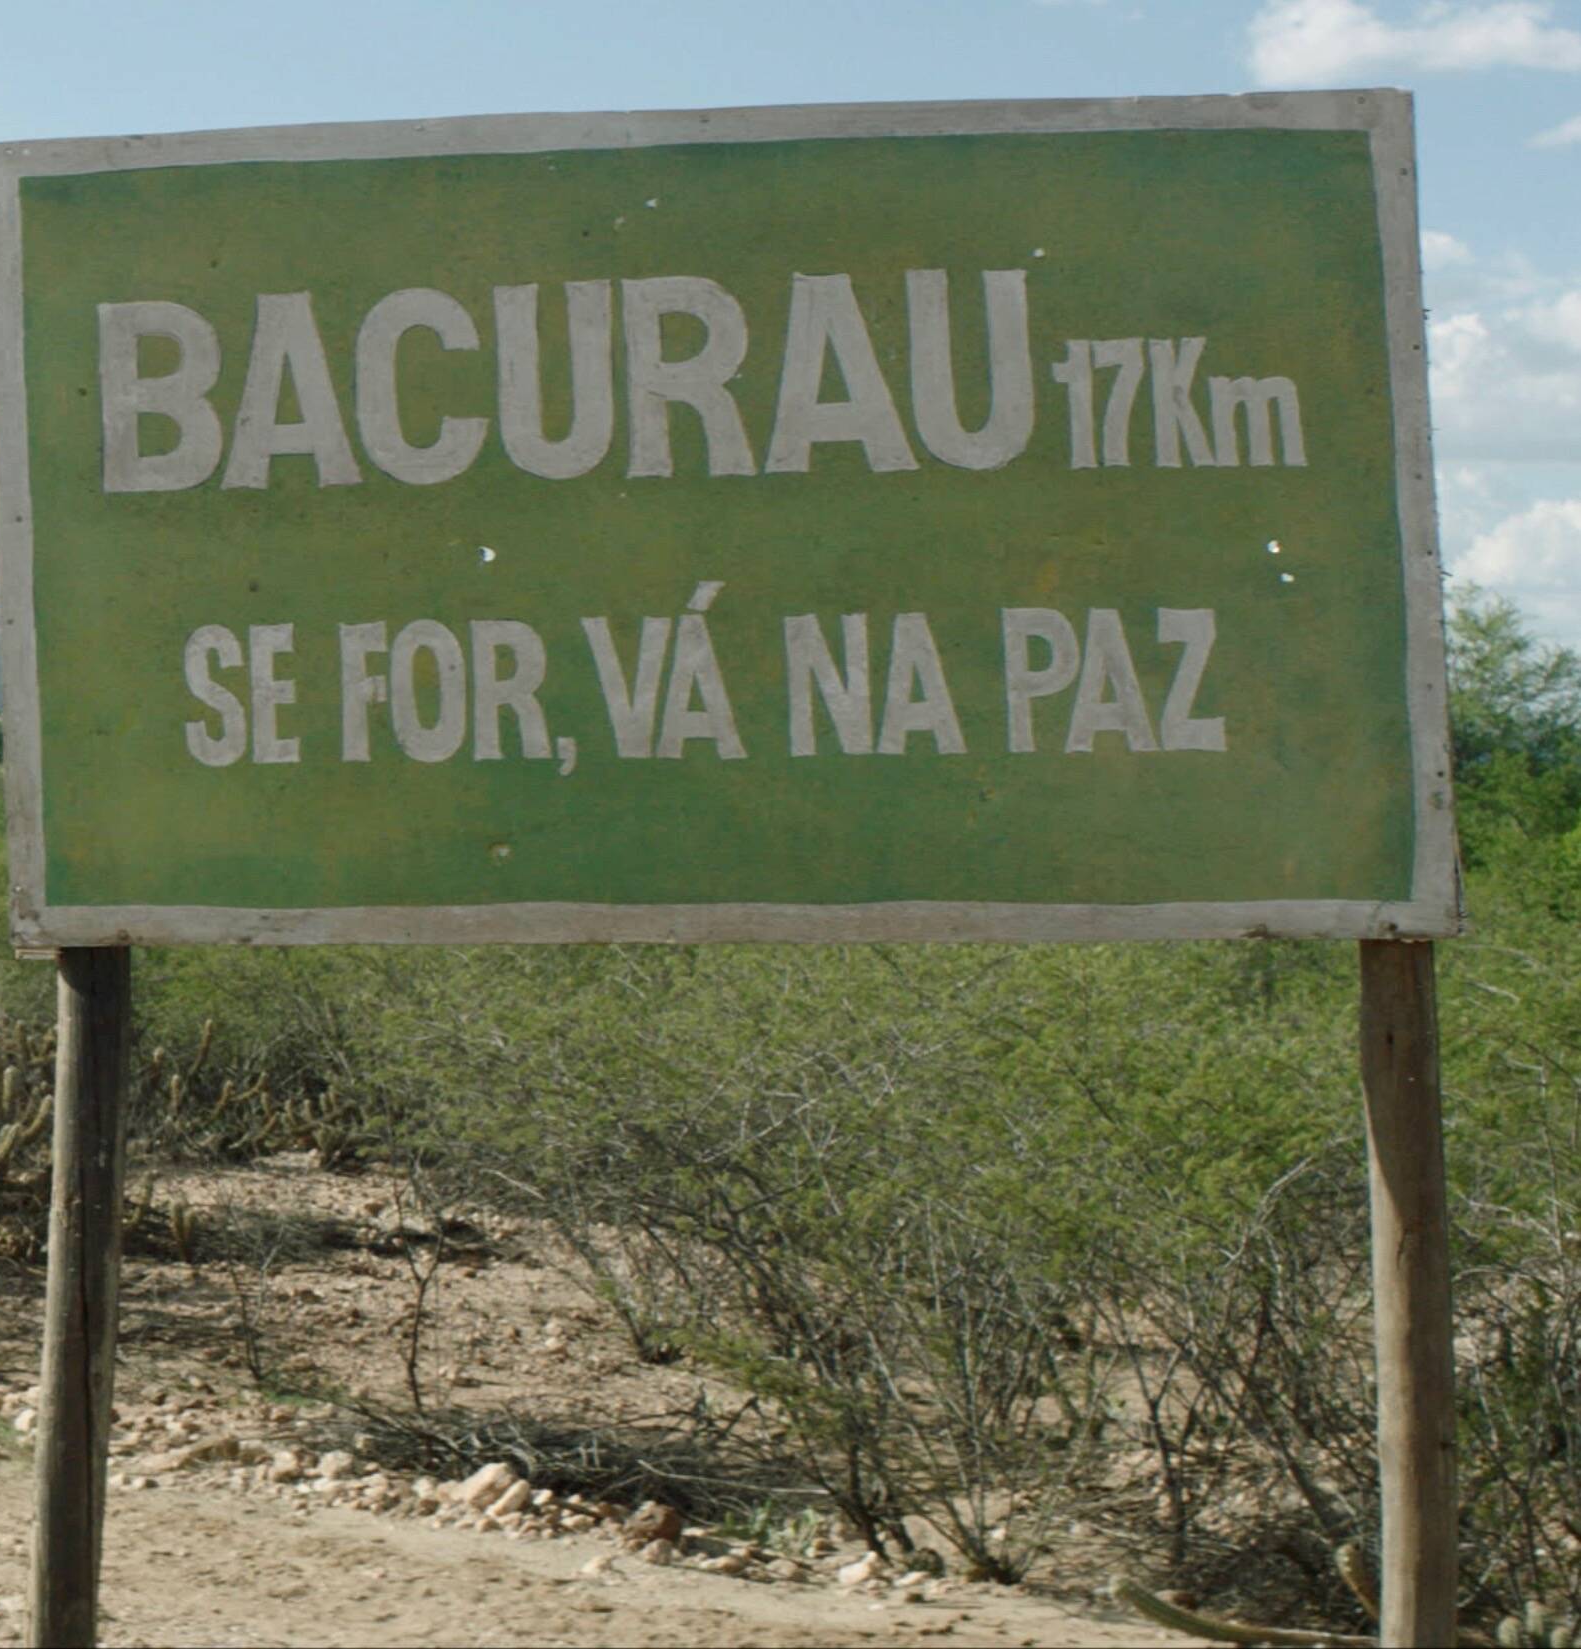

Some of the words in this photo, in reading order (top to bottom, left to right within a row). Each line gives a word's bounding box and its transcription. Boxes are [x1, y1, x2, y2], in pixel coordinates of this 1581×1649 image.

[94, 267, 1036, 495] BACURAU
[1051, 335, 1308, 470] 17Km
[183, 622, 302, 768] SE
[336, 615, 577, 776] FOR,
[579, 580, 748, 761] VÁ
[781, 612, 968, 758] NA
[1000, 606, 1228, 755] PAZ
